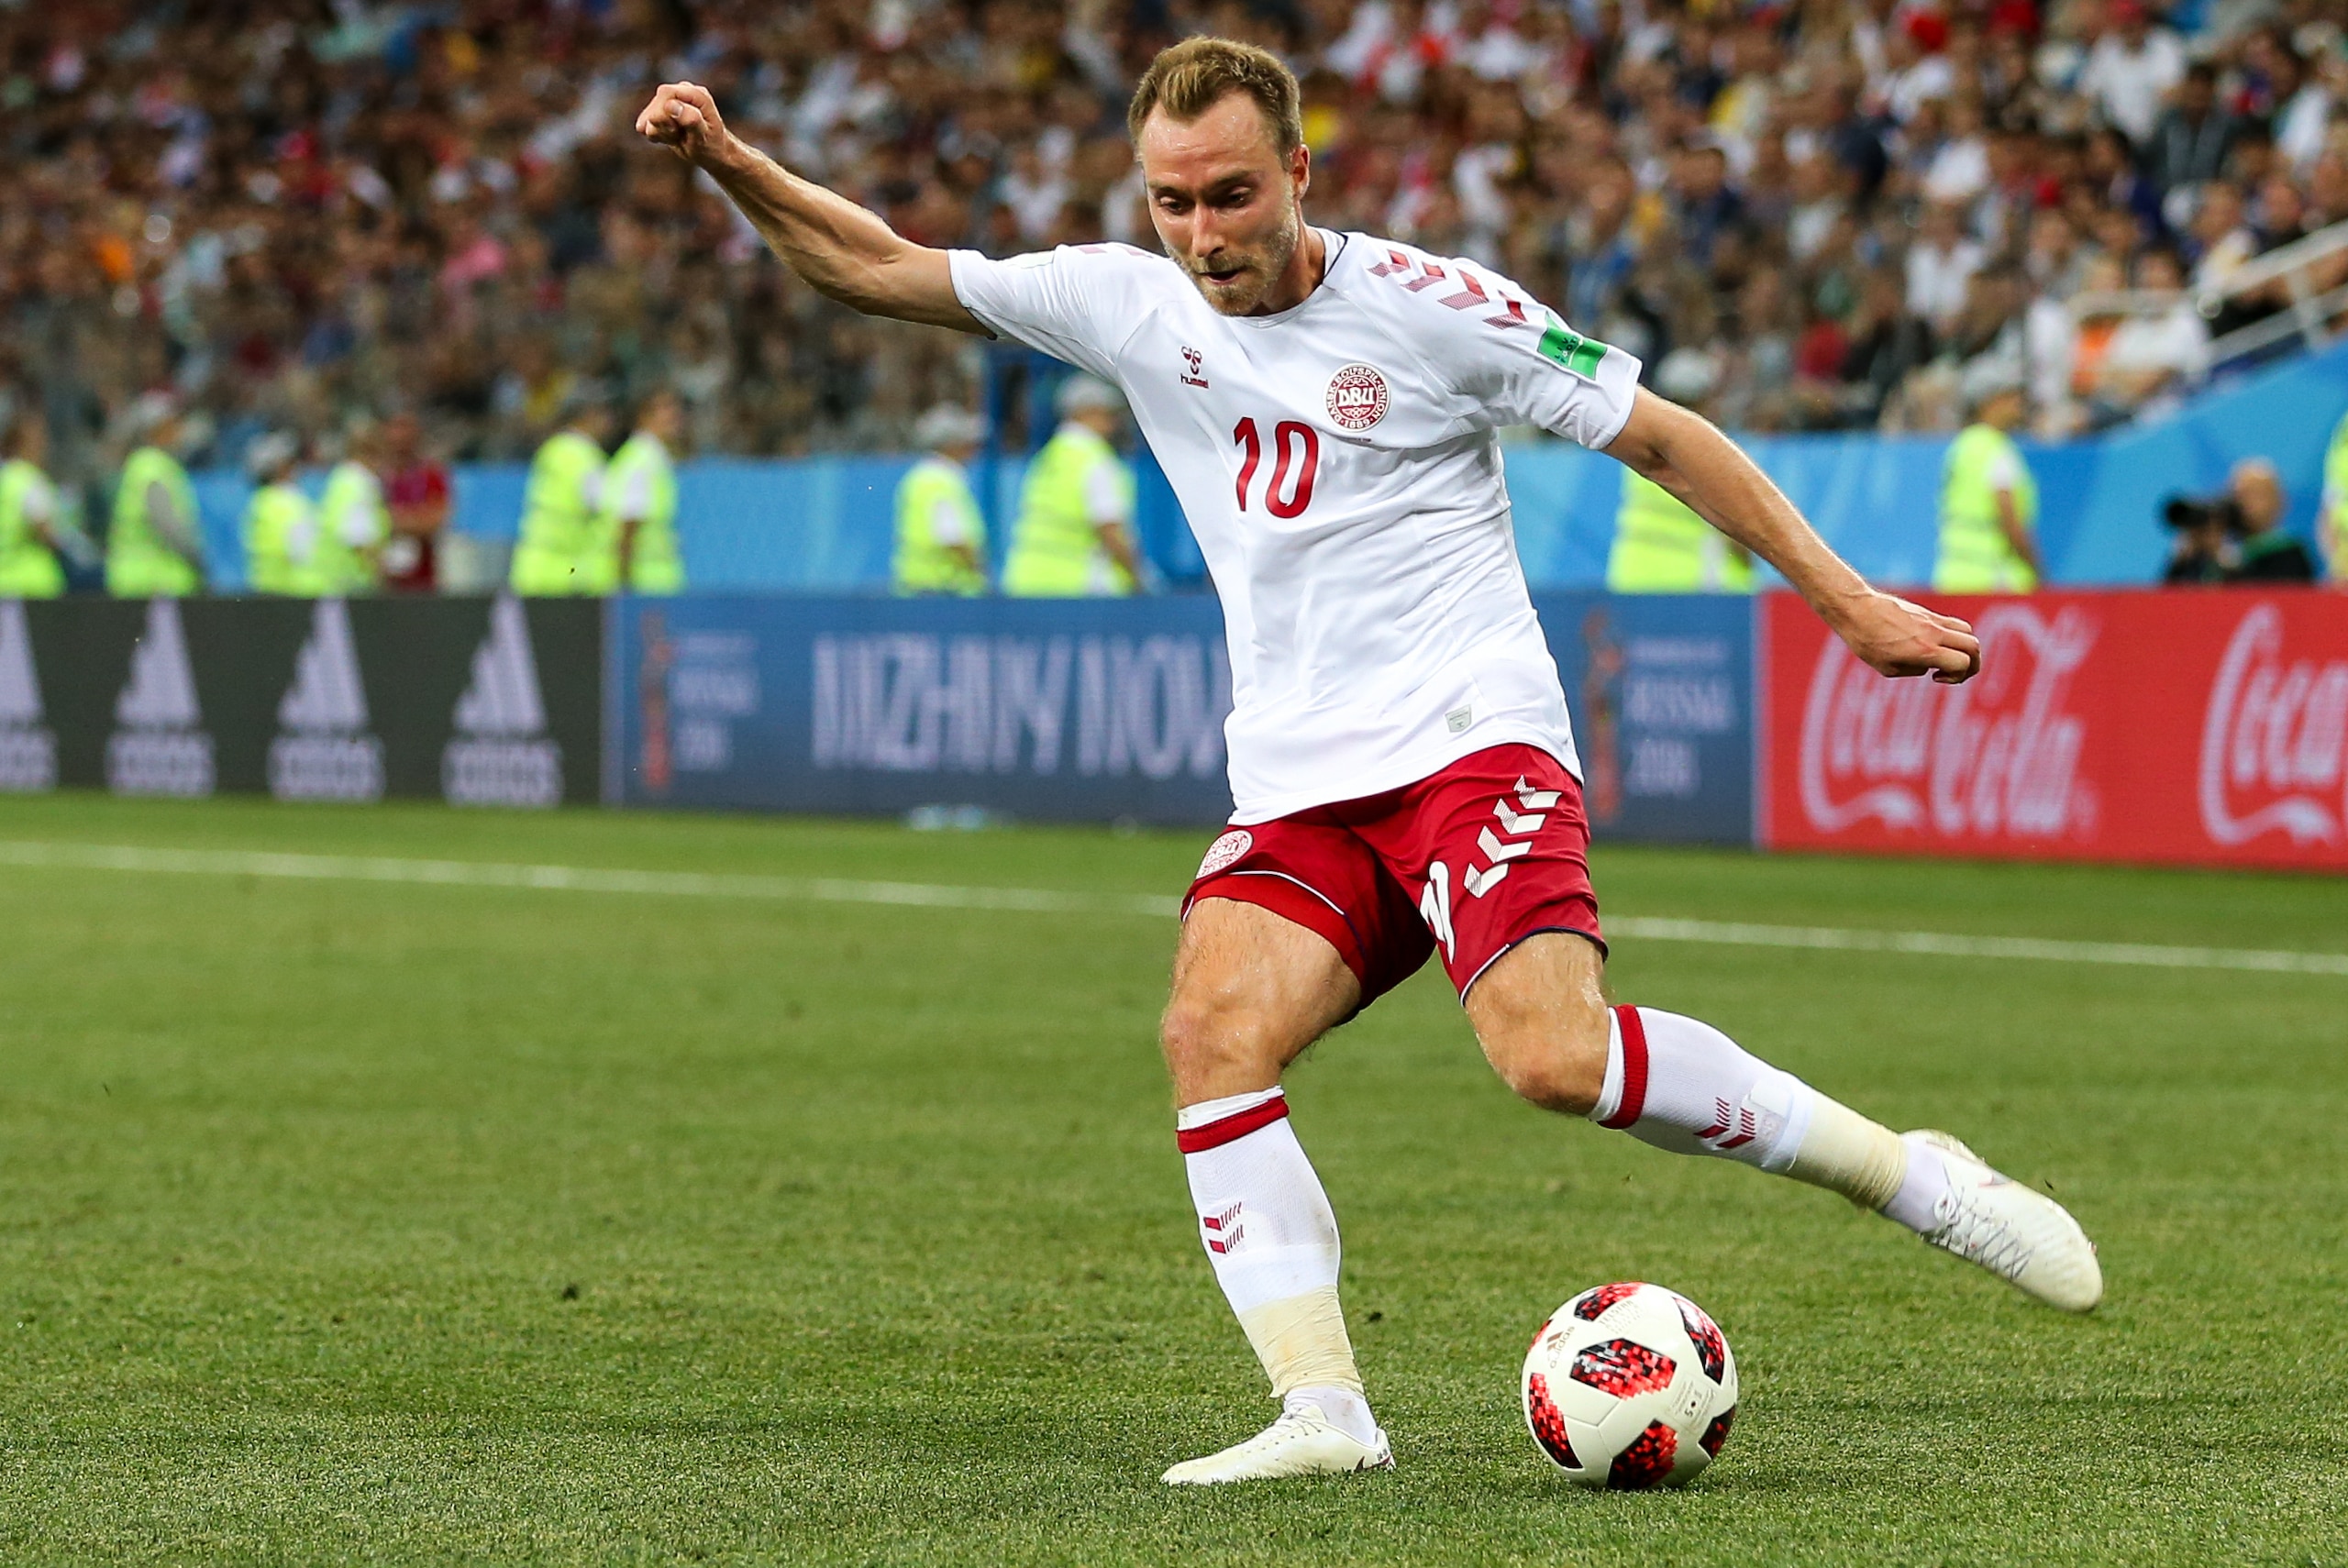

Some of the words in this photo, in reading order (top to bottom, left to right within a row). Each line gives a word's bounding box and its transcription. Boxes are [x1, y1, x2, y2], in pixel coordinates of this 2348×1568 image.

[1326, 386, 1342, 423] DANSK
[1337, 387, 1376, 406] DBU
[1371, 384, 1387, 419] UNION
[1343, 419, 1370, 429] 1889
[1233, 416, 1319, 519] 10
